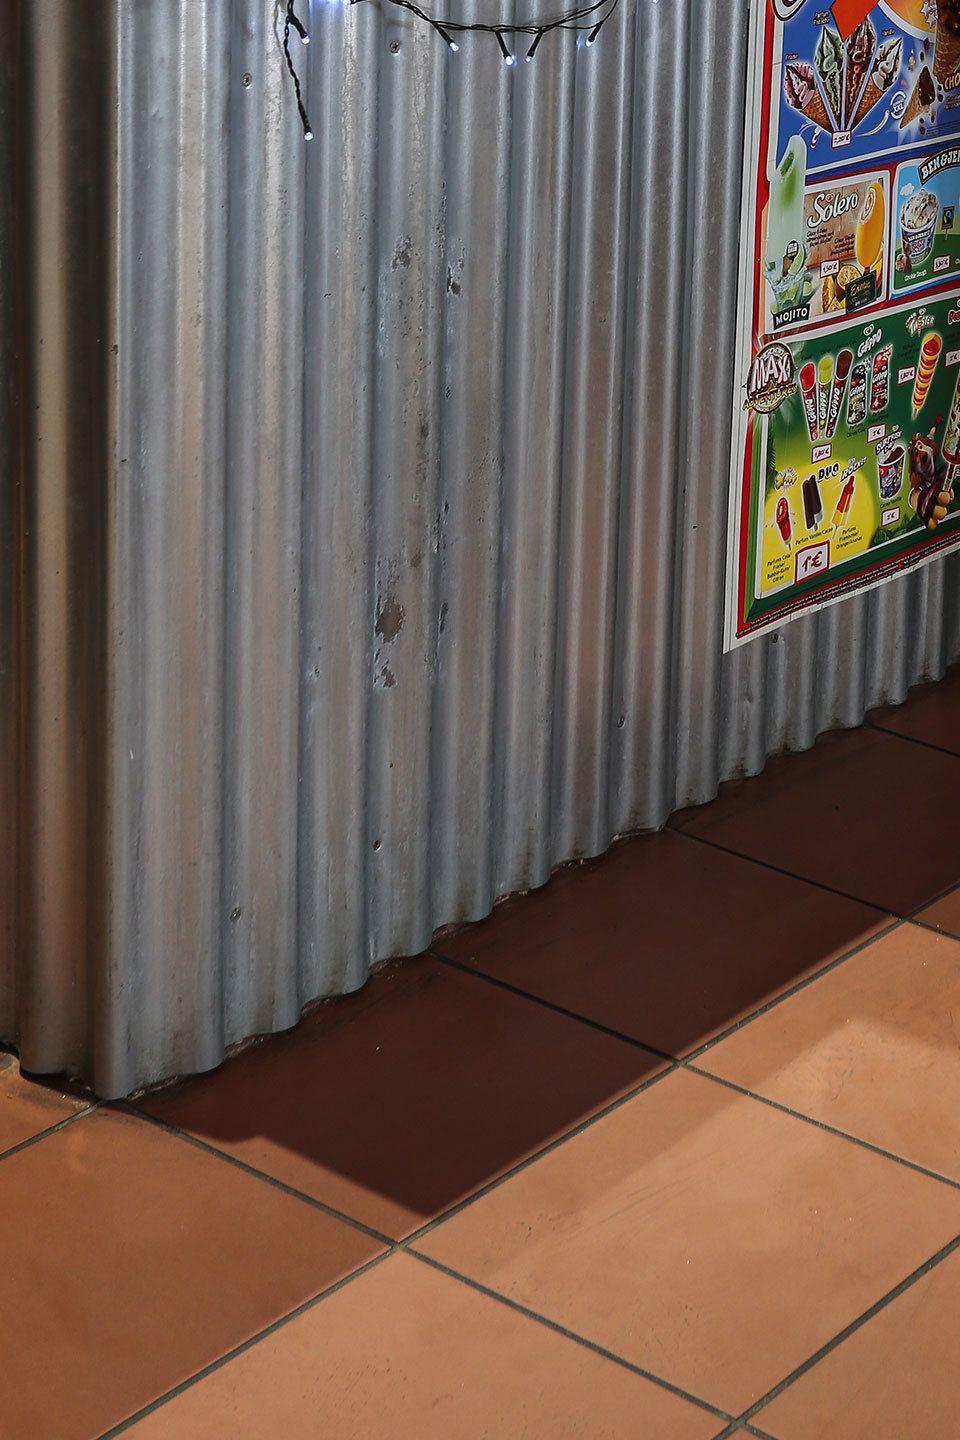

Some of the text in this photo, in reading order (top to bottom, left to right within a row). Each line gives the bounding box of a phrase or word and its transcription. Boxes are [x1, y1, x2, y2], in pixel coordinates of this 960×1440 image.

[807, 191, 859, 228] Solero
[775, 307, 808, 325] MOJITO
[818, 463, 839, 481] DUO
[801, 551, 823, 572] 1€
